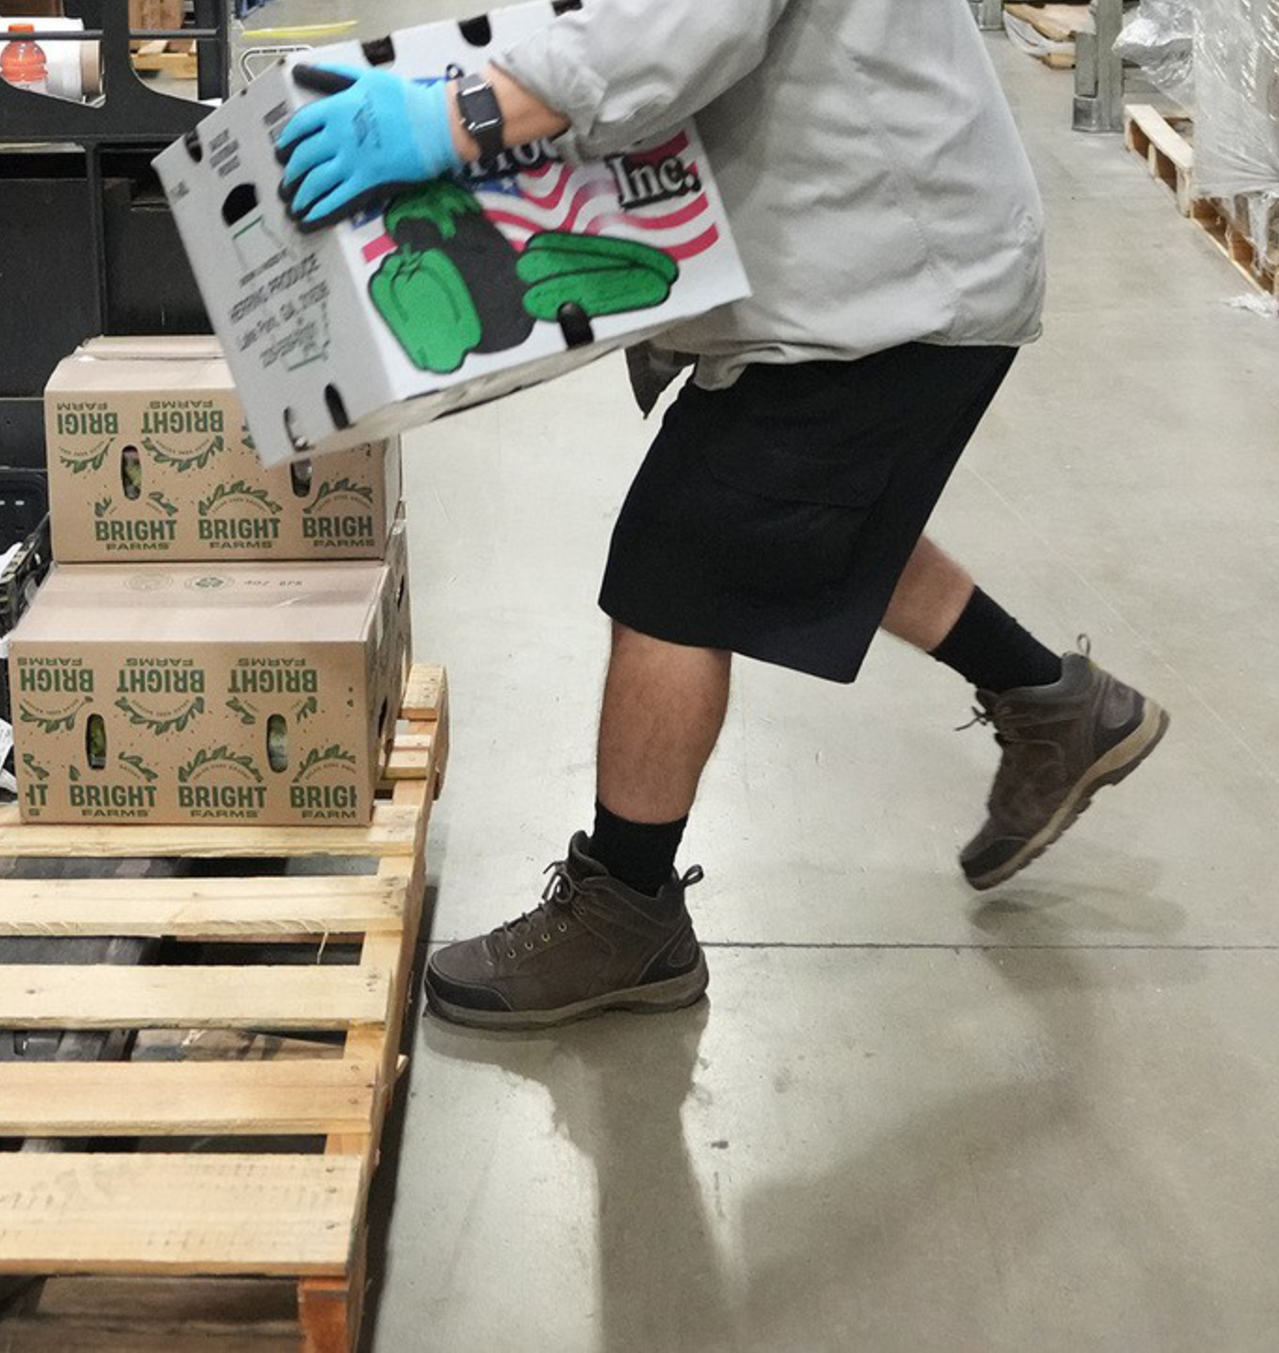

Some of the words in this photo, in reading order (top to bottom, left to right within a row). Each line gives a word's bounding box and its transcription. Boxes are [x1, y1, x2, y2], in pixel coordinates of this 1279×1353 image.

[606, 153, 698, 207] Inc.
[142, 410, 225, 435] BRIGHT
[95, 518, 177, 542] BRIGHT
[198, 518, 281, 542] BRIGHT
[117, 669, 205, 693] BRIGHT
[228, 669, 318, 693] BRIGHT
[69, 785, 158, 808] BRIGHT
[178, 785, 268, 809] BRIGHT
